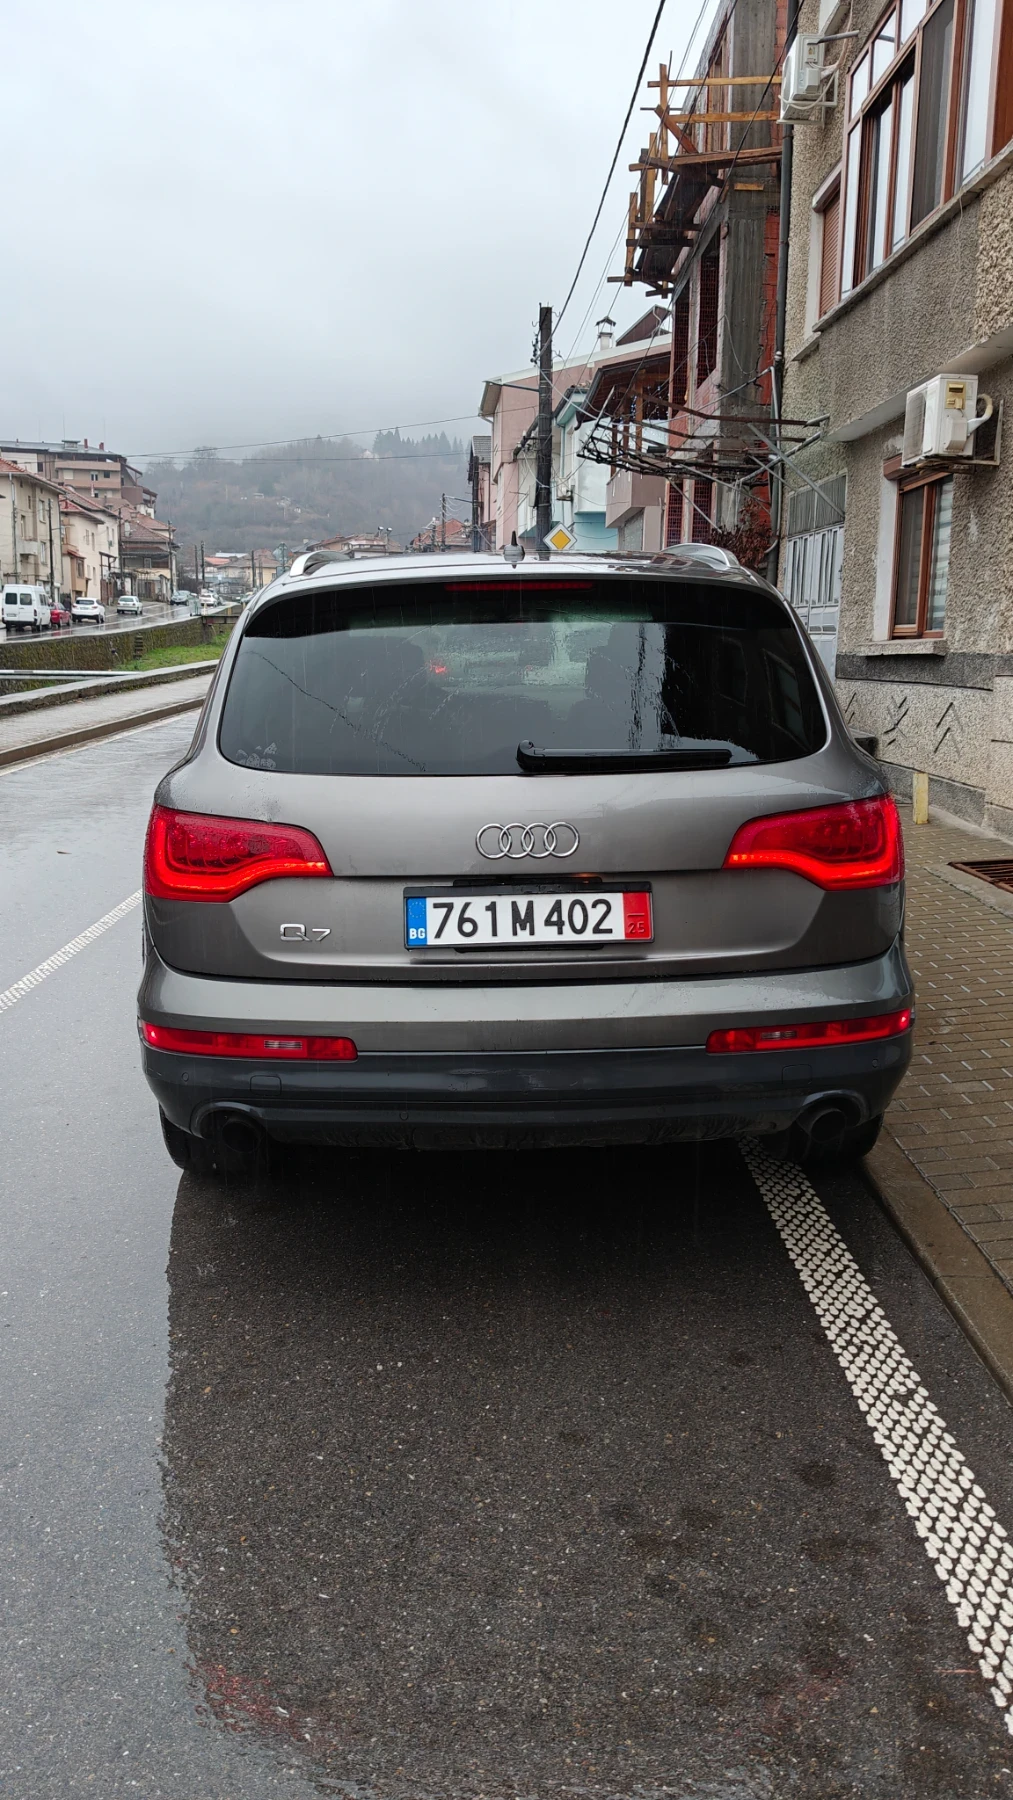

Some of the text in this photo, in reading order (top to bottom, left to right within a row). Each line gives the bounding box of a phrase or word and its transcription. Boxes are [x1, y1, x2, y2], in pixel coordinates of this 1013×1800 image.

[279, 923, 332, 942] Q7
[409, 928, 426, 940] BG
[627, 921, 646, 935] 25
